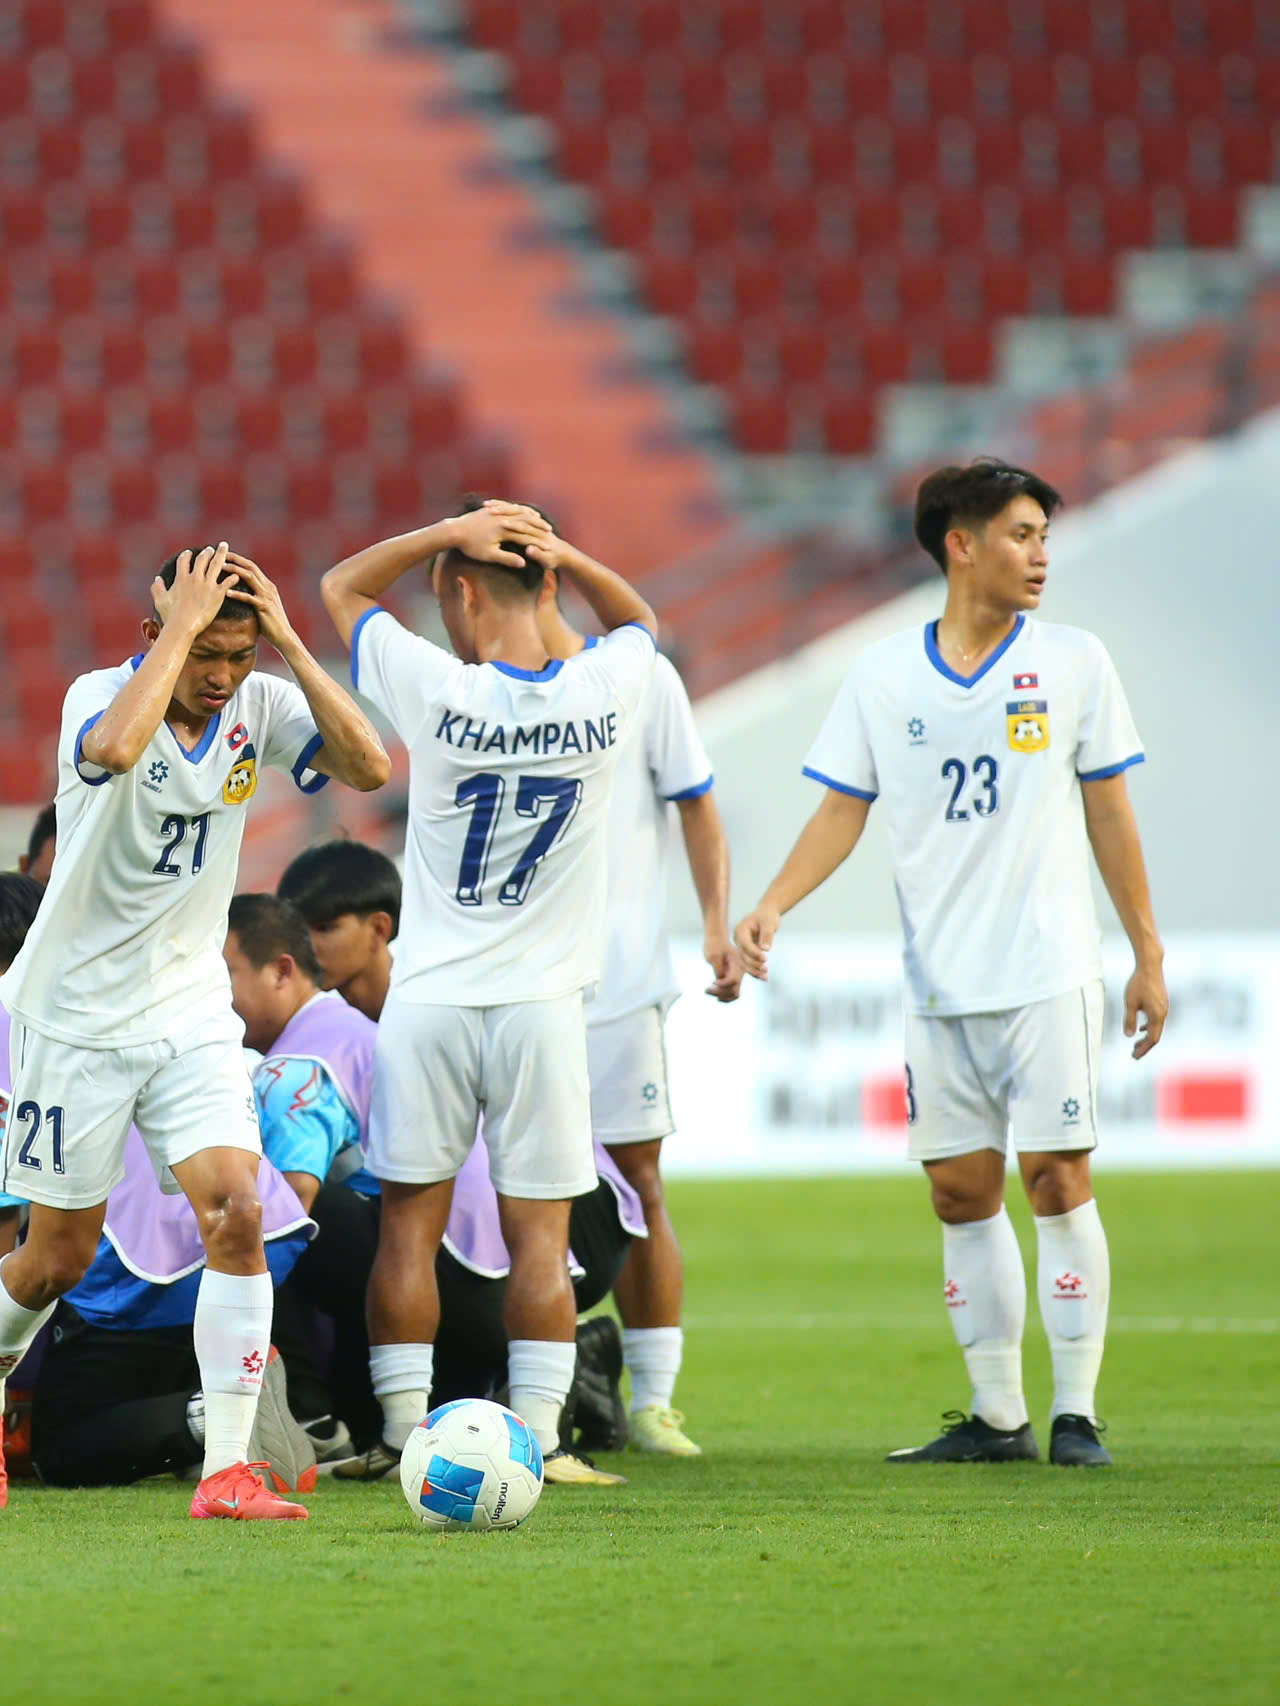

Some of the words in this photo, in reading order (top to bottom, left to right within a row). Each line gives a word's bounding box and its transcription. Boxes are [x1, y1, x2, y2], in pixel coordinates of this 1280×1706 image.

[435, 709, 617, 755] KHAMPANE
[941, 754, 1000, 823] 23
[152, 811, 212, 877] 21
[454, 772, 584, 906] 17
[16, 1100, 65, 1175] 21
[490, 1481, 509, 1521] molten
